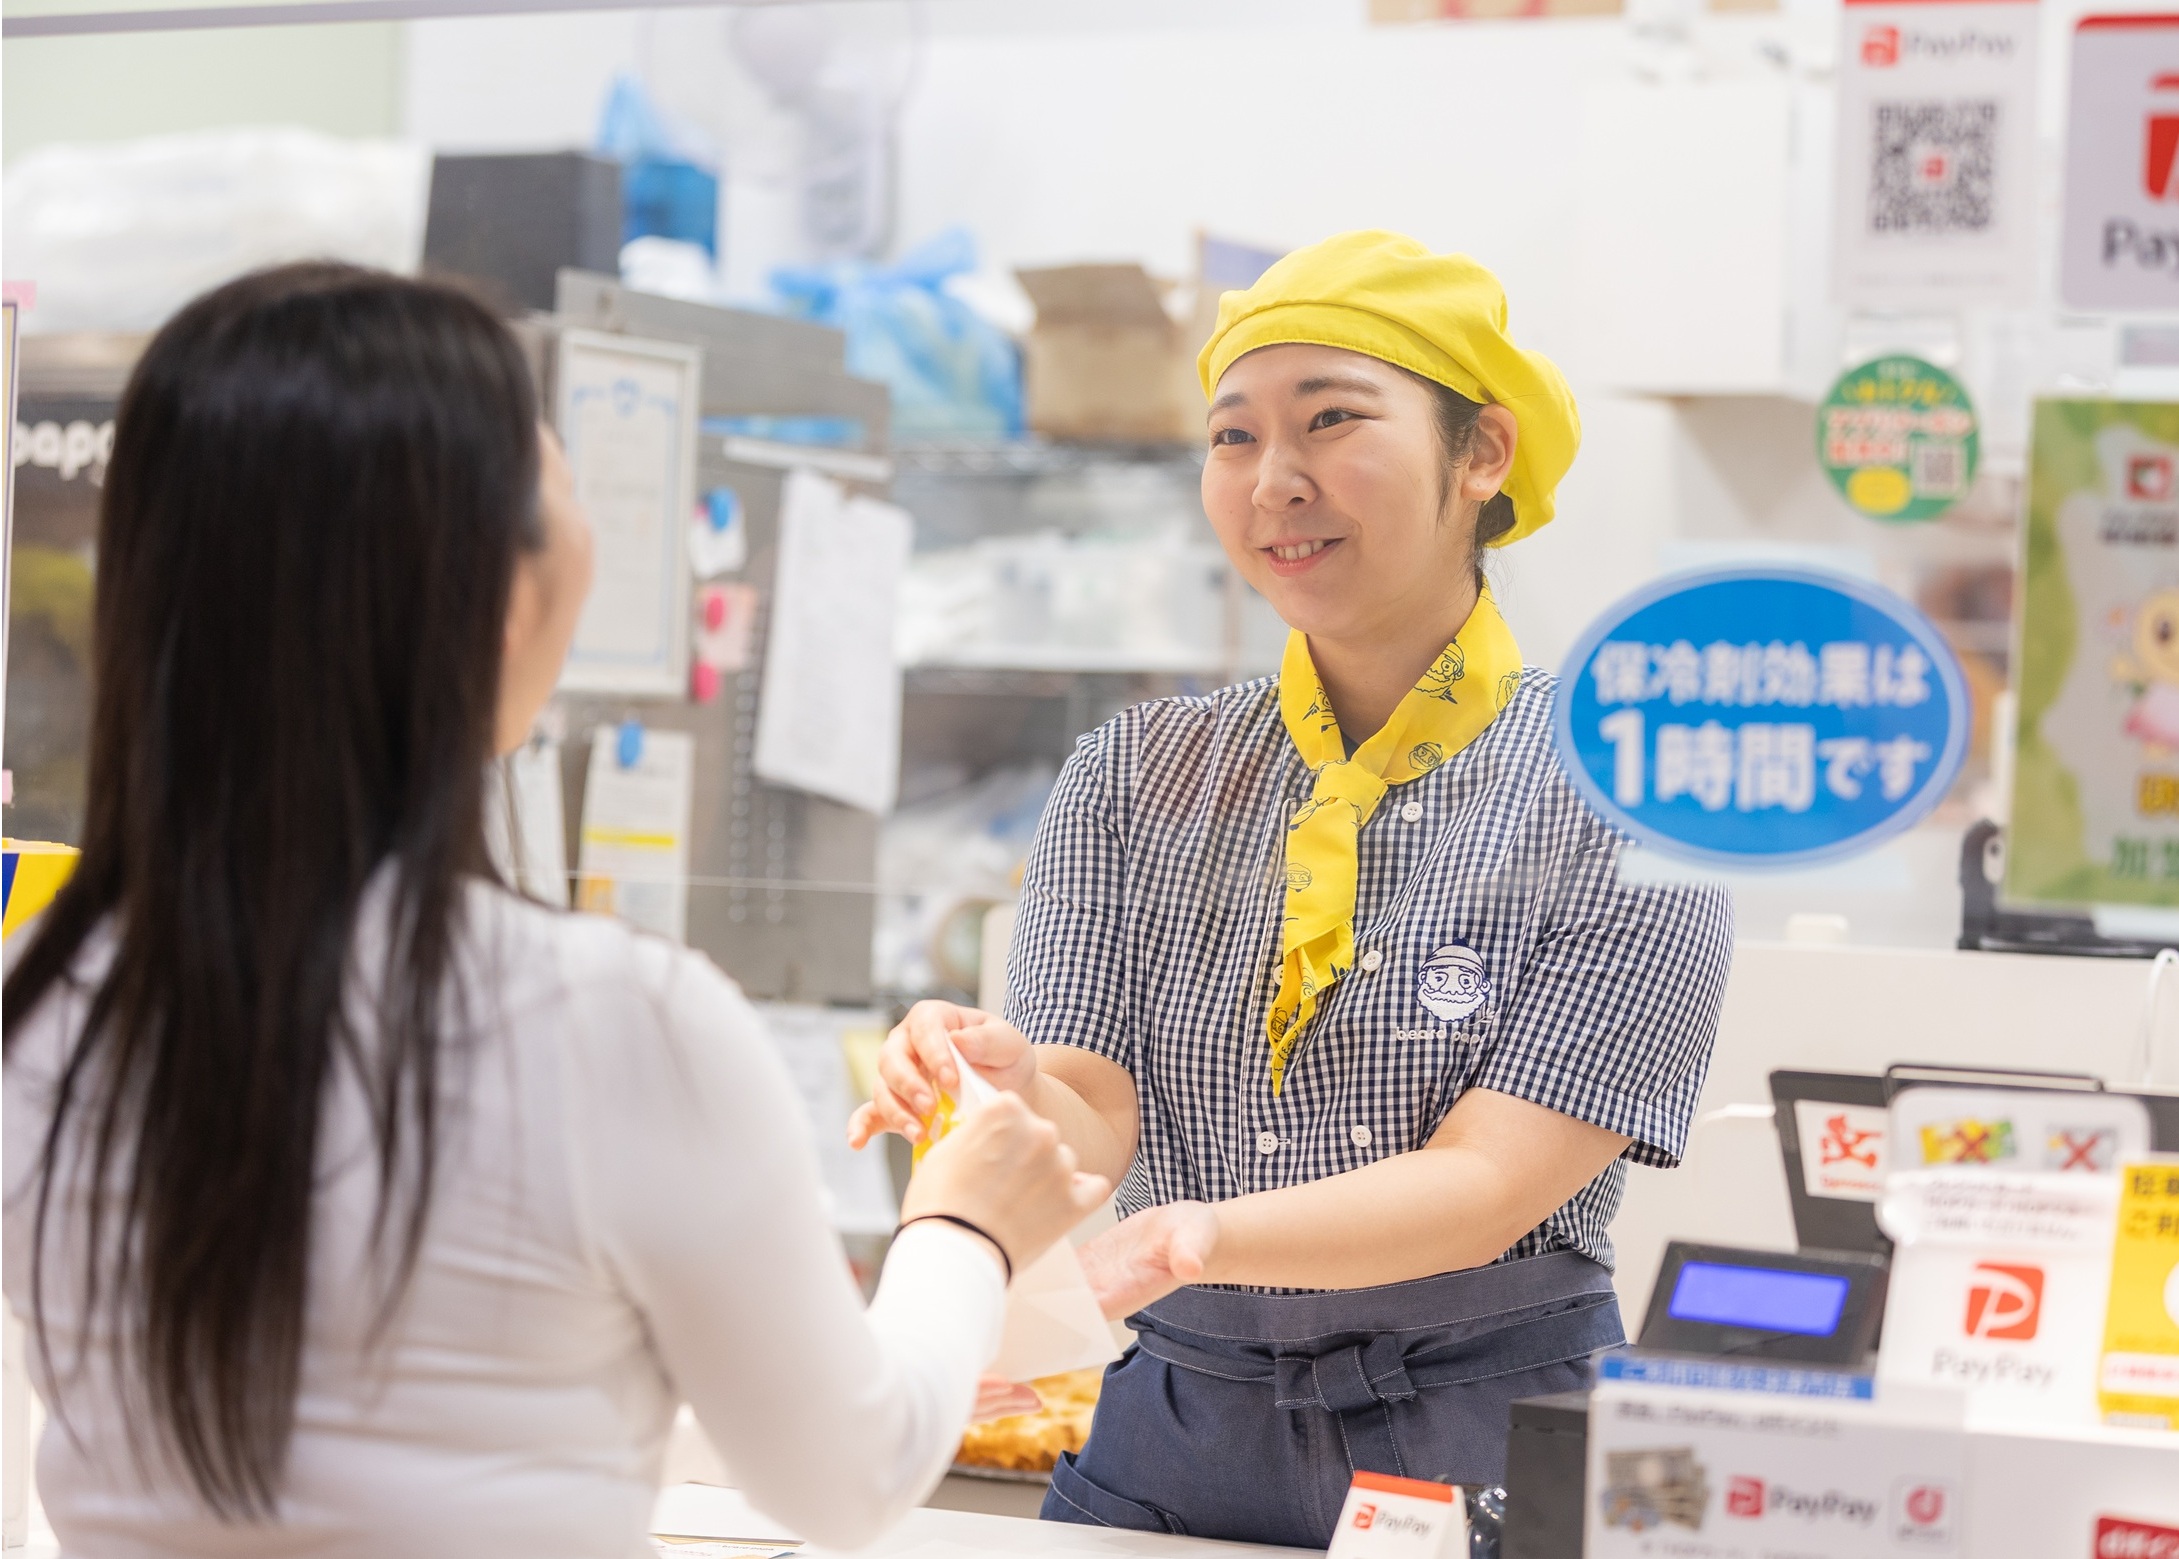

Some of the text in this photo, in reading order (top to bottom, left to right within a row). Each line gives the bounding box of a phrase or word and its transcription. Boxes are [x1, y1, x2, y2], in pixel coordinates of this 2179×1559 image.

[1592, 640, 1931, 707] 保冷剤効果は
[1599, 708, 1933, 813] 1時間です
[1396, 1025, 1447, 1041] beard
[1932, 1347, 2057, 1385] PayPay
[1376, 1508, 1431, 1537] PayPay
[1768, 1484, 1880, 1526] PayPay
